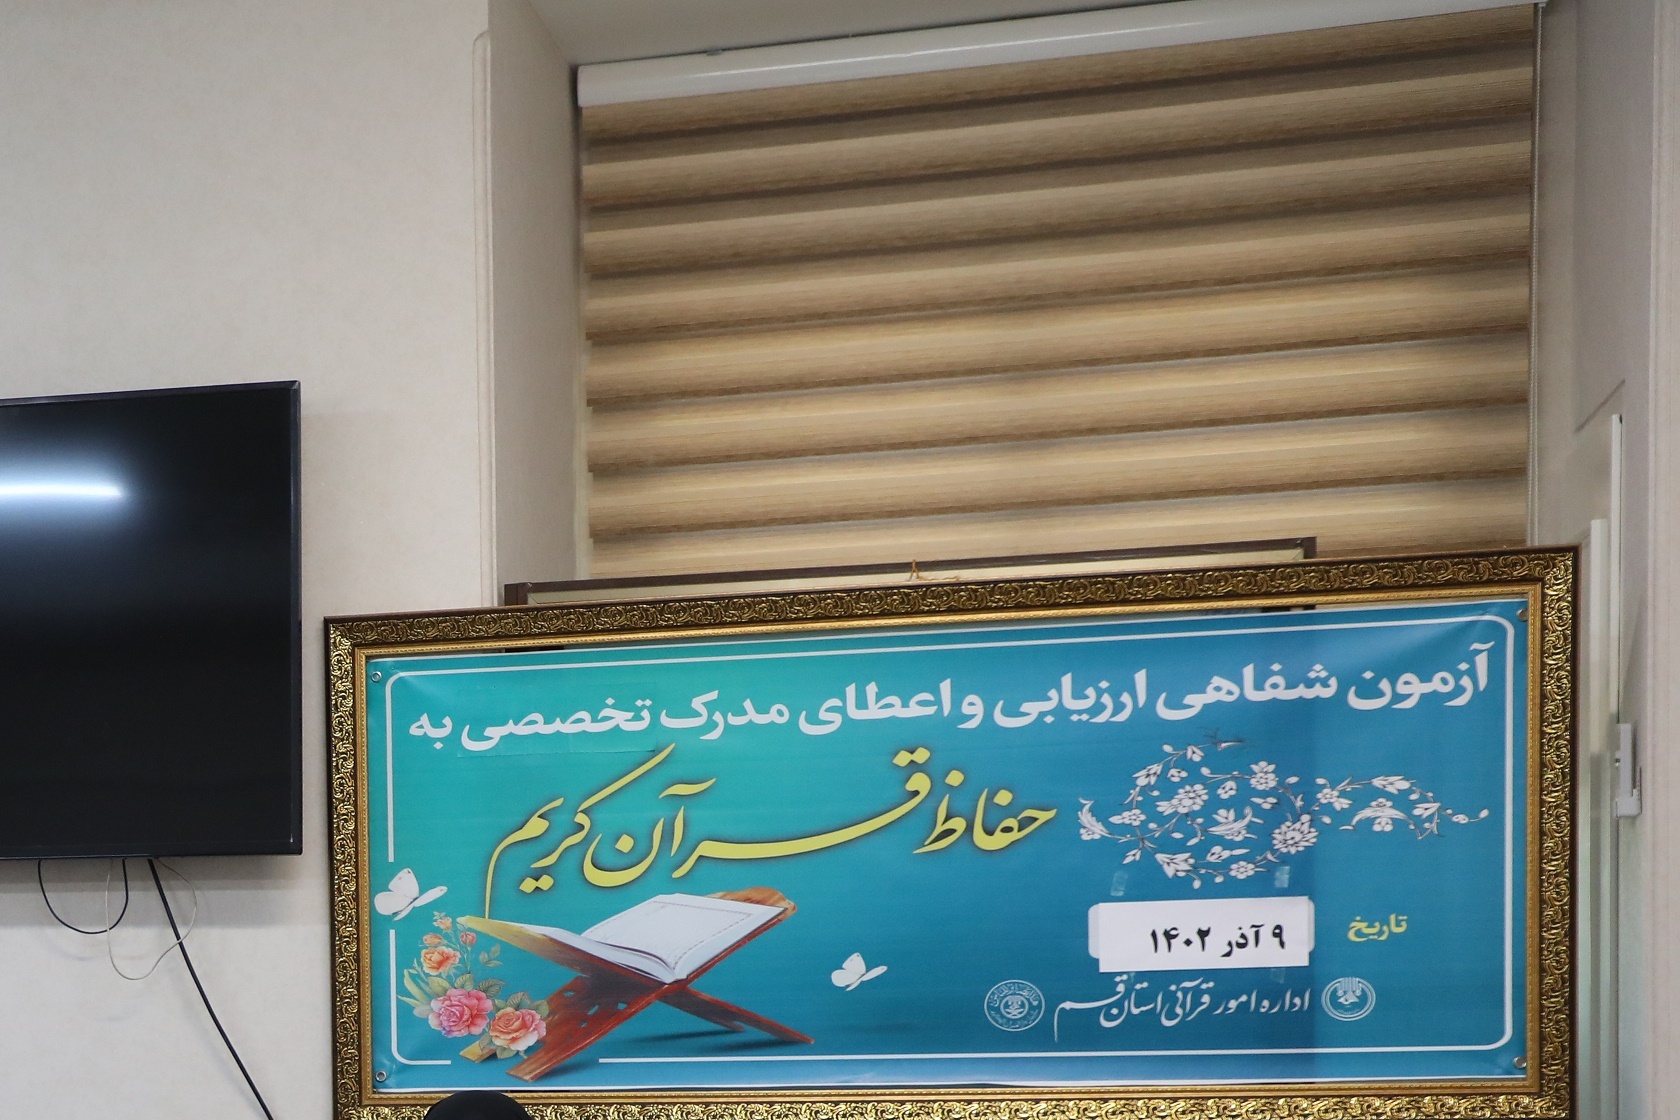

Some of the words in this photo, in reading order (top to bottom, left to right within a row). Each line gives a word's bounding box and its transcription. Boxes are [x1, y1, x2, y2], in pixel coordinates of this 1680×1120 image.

[993, 668, 1148, 729] ارزیابی
[1155, 662, 1339, 721] شفاهی
[1347, 641, 1495, 711] آزمون
[409, 713, 454, 750] به
[461, 697, 652, 752] تخصصی
[659, 689, 790, 741] مدرک
[798, 678, 952, 736] اعطای
[957, 693, 985, 729] و
[484, 743, 676, 919] کریم
[583, 746, 932, 887] قرآن
[914, 769, 1057, 854] حفاظ
[1149, 926, 1212, 953] ۱۴۰۲
[1220, 923, 1265, 958] آذر
[1271, 924, 1286, 949] ۹
[1347, 913, 1408, 942] تاریخ
[1053, 972, 1130, 1043] قم
[1098, 981, 1163, 1029] استان
[1159, 977, 1216, 1028] قرآنی
[1212, 990, 1257, 1015] امور
[1259, 988, 1311, 1014] اداره
